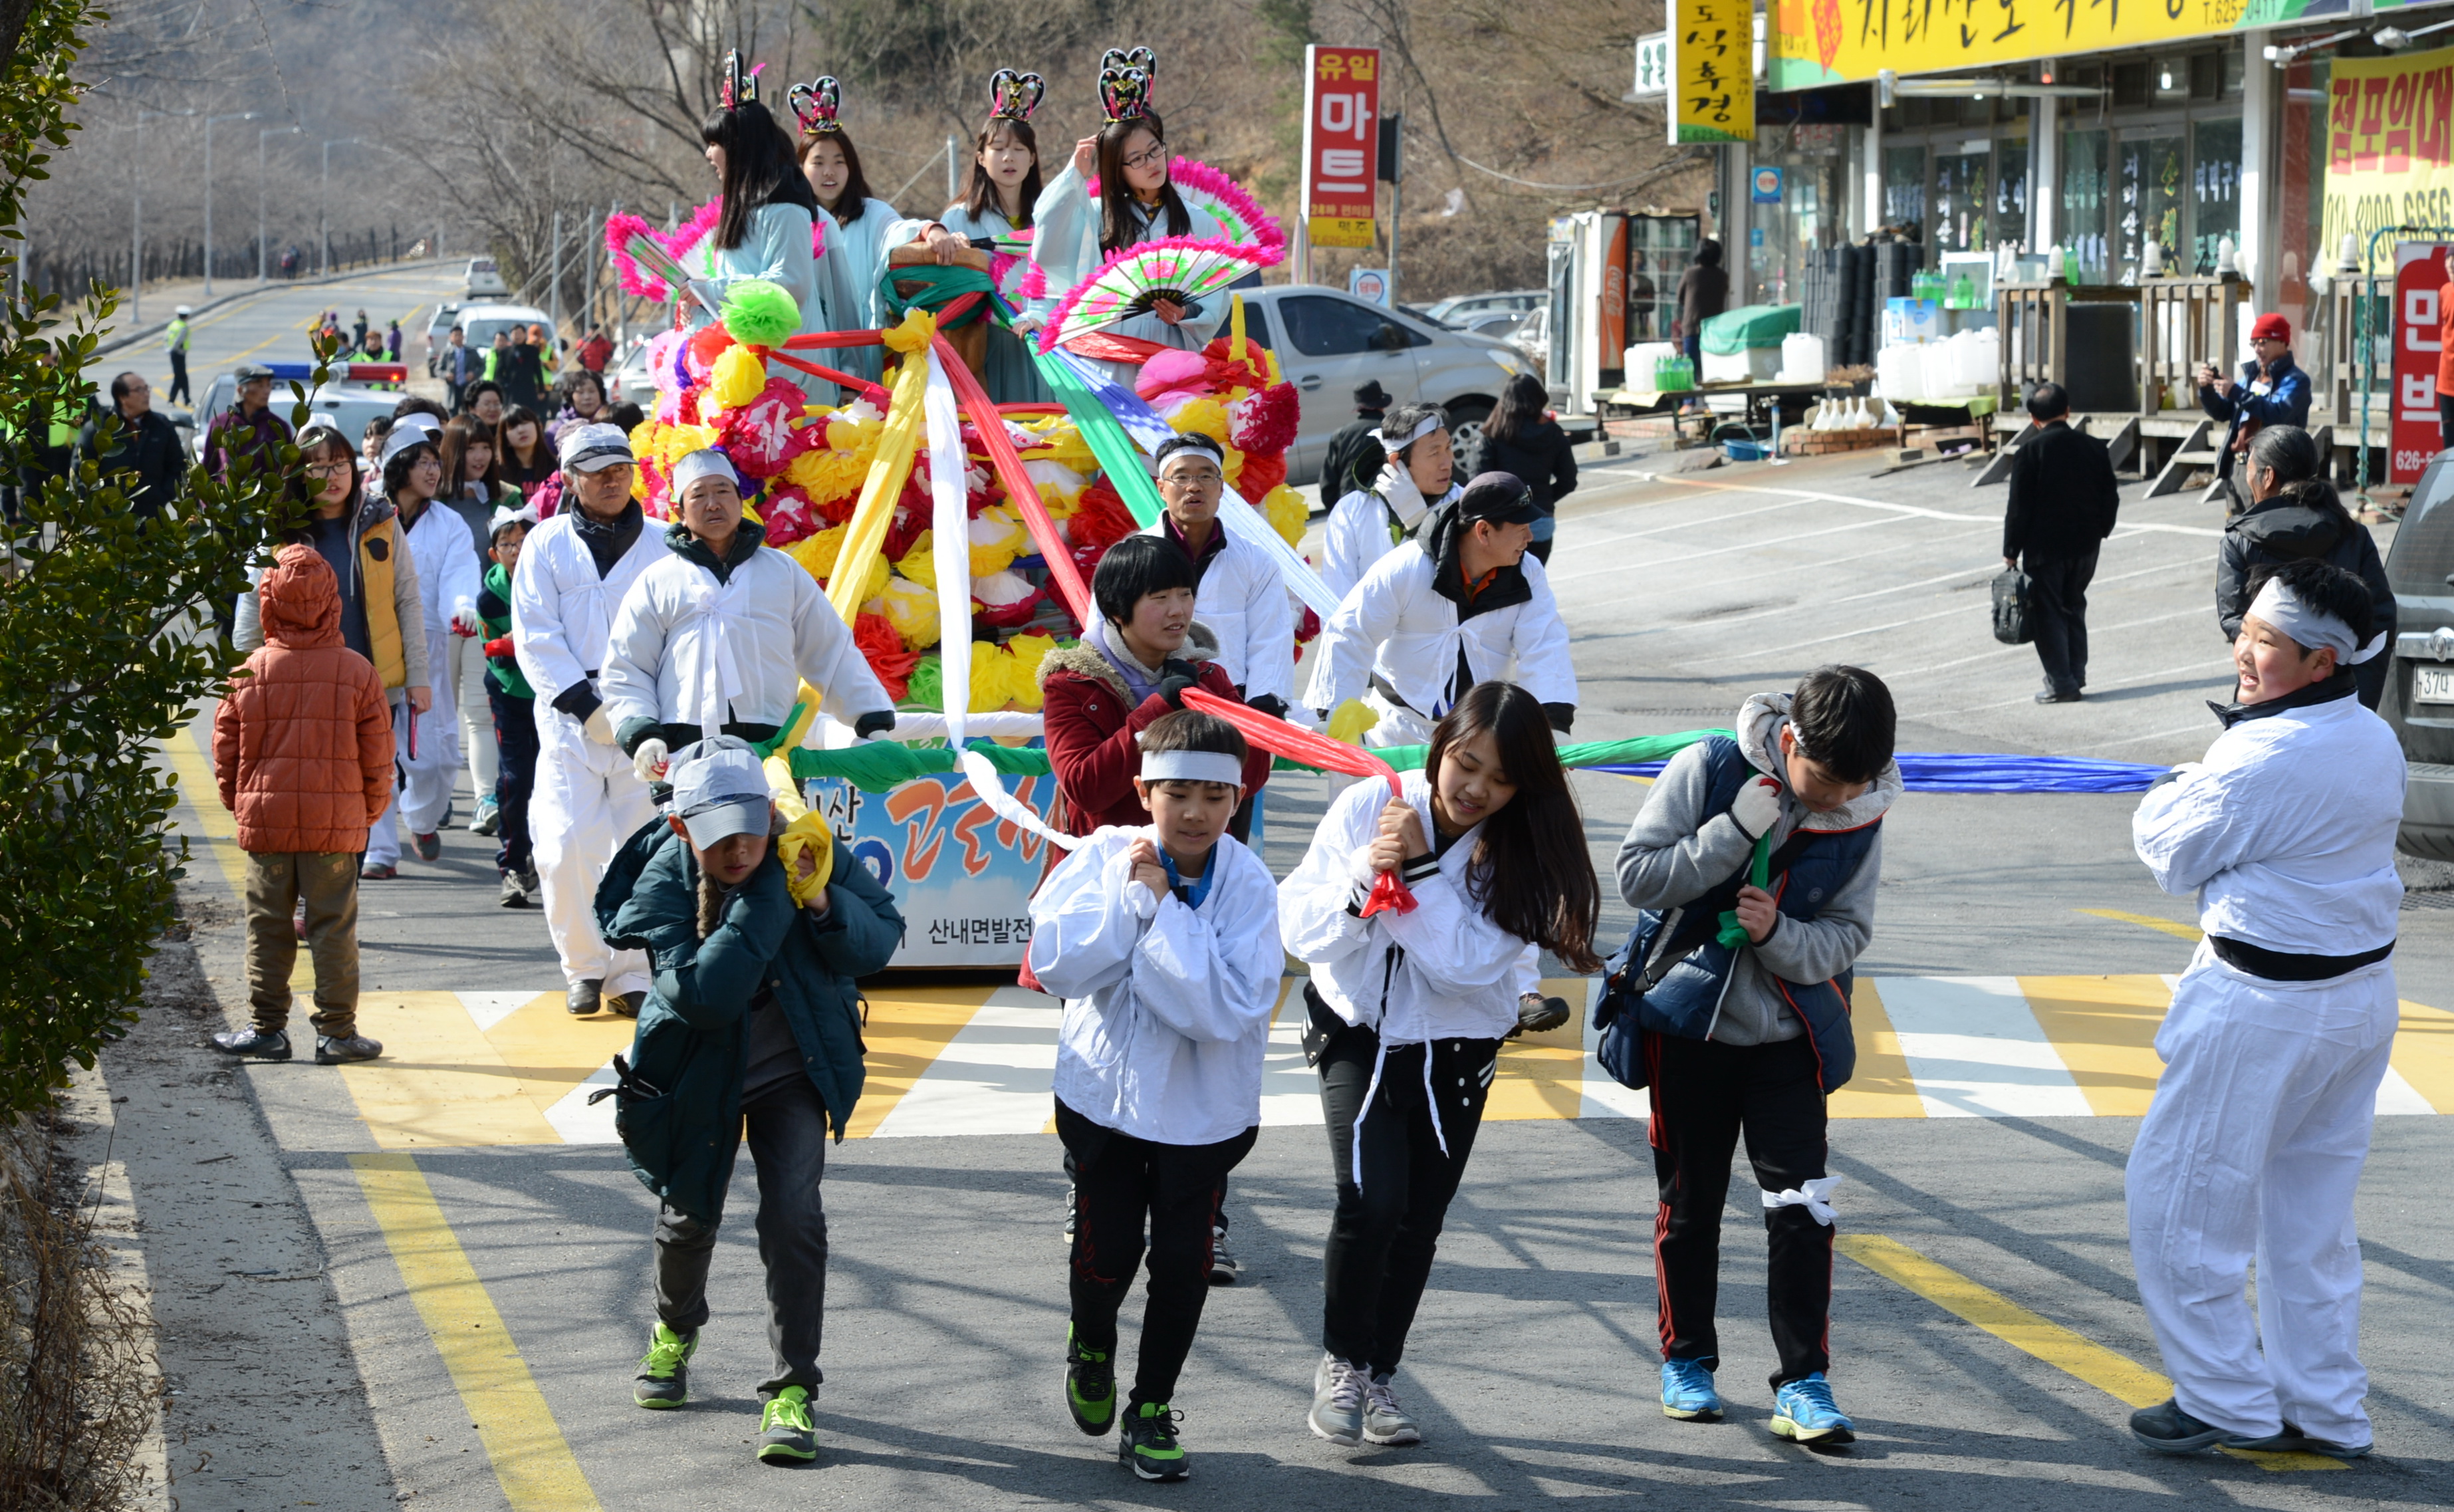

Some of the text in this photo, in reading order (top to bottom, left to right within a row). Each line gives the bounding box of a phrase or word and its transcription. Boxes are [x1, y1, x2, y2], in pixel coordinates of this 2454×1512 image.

[1316, 54, 1375, 81] 유일
[1317, 92, 1372, 193] 마트
[2331, 65, 2454, 175] 점포임대
